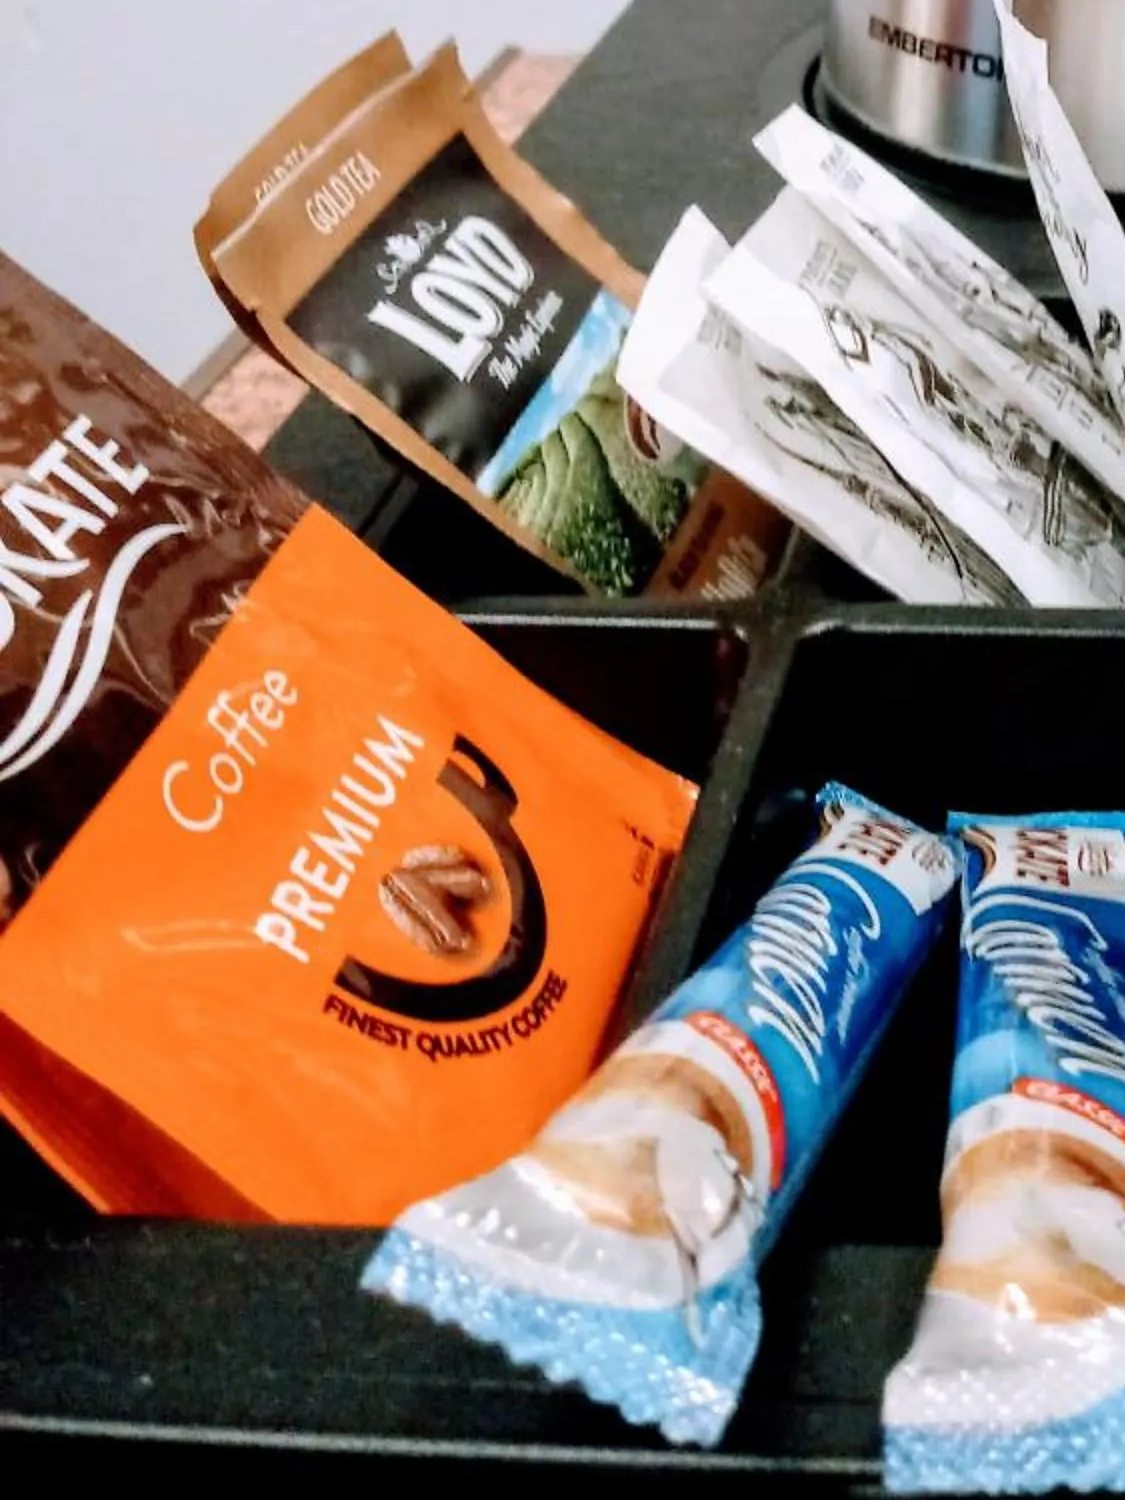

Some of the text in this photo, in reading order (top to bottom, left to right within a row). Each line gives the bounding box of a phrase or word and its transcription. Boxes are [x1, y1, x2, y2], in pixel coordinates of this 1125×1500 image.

[305, 148, 381, 235] GOLD TEA
[367, 216, 534, 383] LOYD
[0, 414, 149, 652] KATE
[163, 670, 300, 833] Coffee
[254, 714, 426, 964] PREMIUM
[323, 969, 568, 1063] FINEST QUALITY COFFEE
